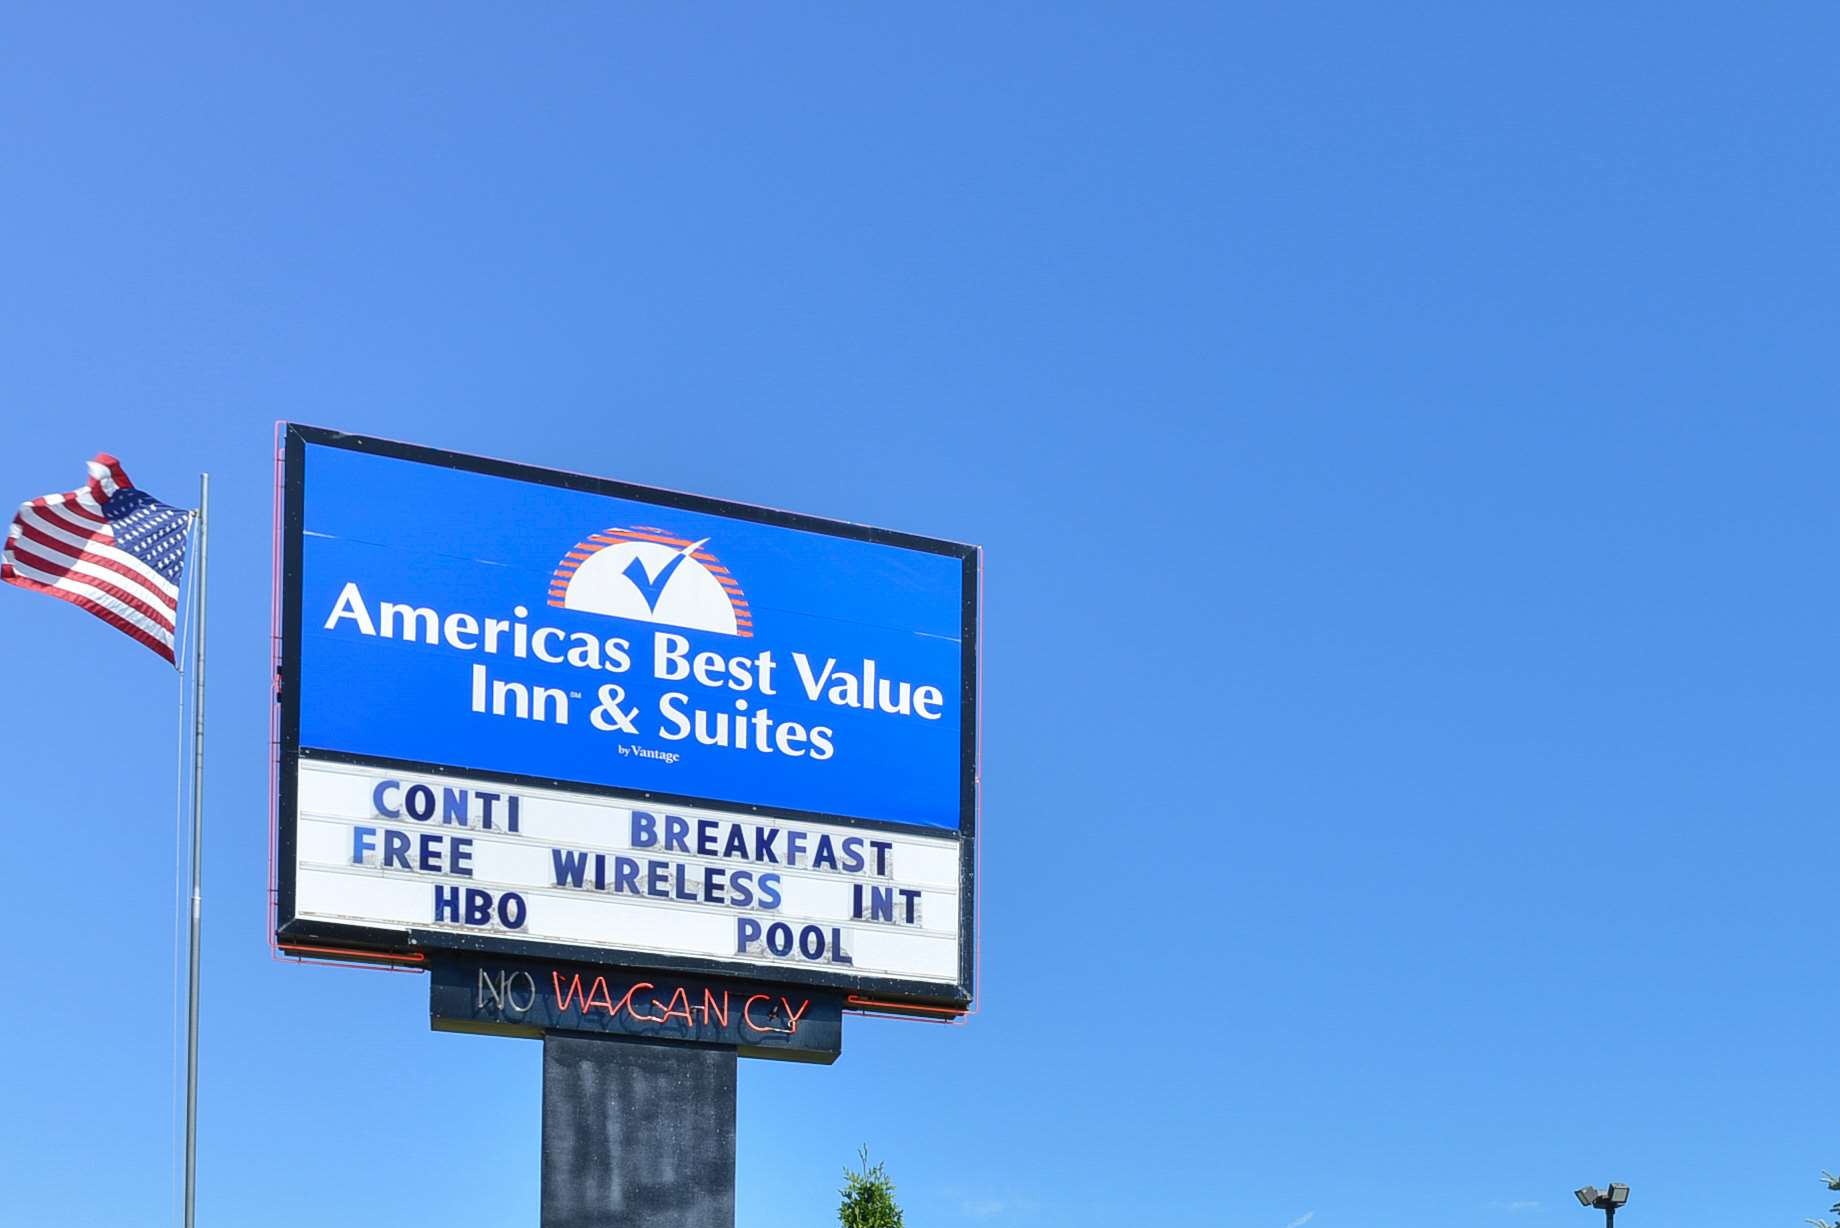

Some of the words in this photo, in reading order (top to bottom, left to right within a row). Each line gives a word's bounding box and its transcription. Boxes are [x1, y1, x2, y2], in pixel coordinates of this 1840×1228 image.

[324, 582, 631, 673] Americas
[654, 632, 776, 695] Best
[792, 652, 943, 720] Value
[472, 664, 568, 725] Inn
[590, 684, 640, 734] &
[658, 692, 834, 760] Suites
[618, 745, 630, 757] by
[631, 745, 680, 763] Vantage
[353, 826, 473, 876] FREE
[552, 849, 781, 909] WIRELESS
[853, 884, 921, 924] INT
[373, 779, 520, 833] CONTI
[631, 811, 892, 876] BREAKFAST
[434, 885, 527, 930] HBO
[737, 917, 853, 964] POOL
[478, 968, 535, 1013] NO
